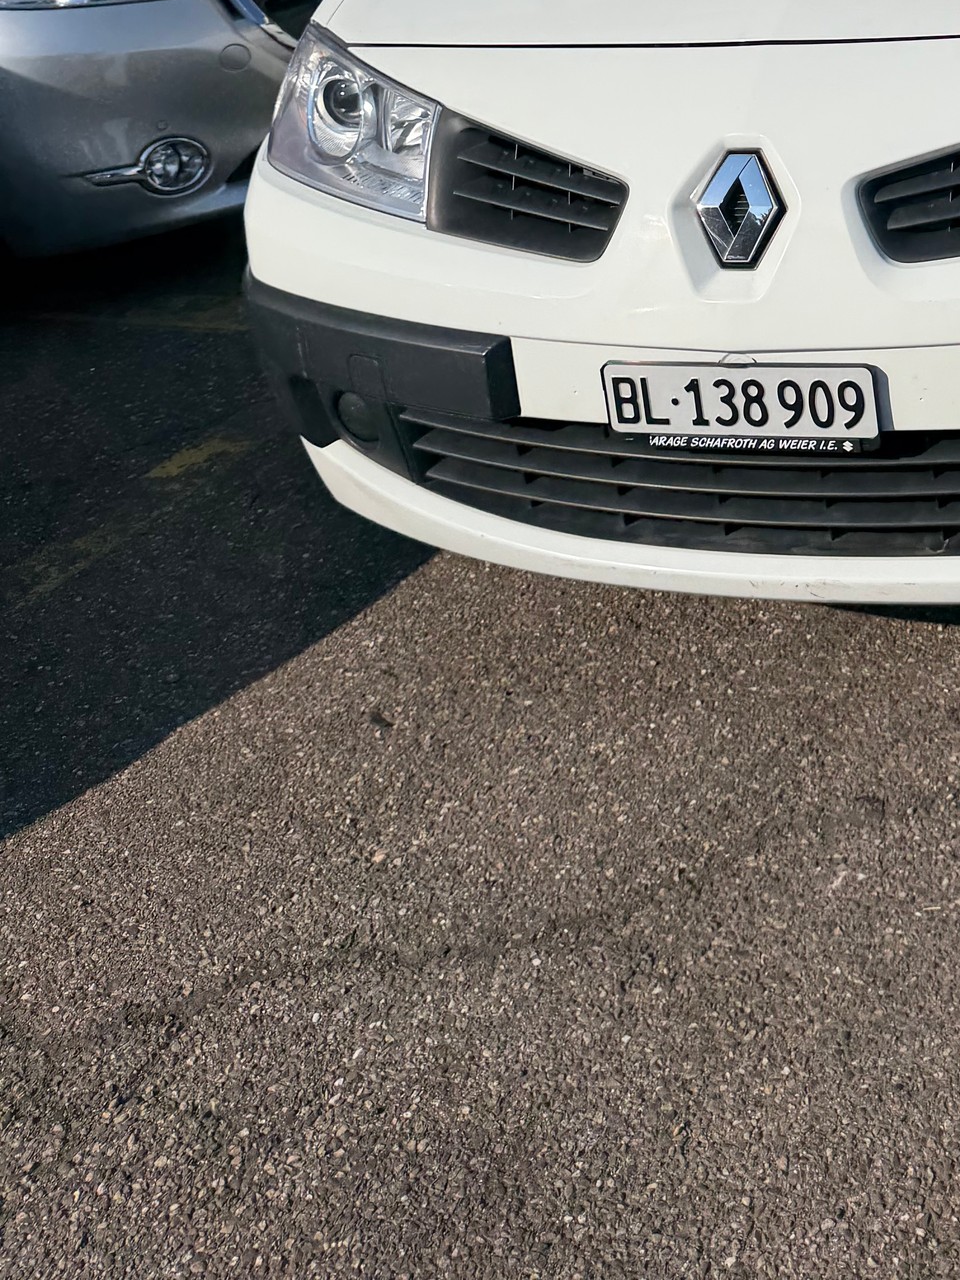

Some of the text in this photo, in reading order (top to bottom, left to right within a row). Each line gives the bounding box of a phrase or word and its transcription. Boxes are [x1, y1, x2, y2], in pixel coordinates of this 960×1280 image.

[690, 436, 759, 449] SCHAFROTH
[758, 438, 775, 450] AG
[778, 439, 817, 451] WEIER
[819, 440, 839, 451] I.E.
